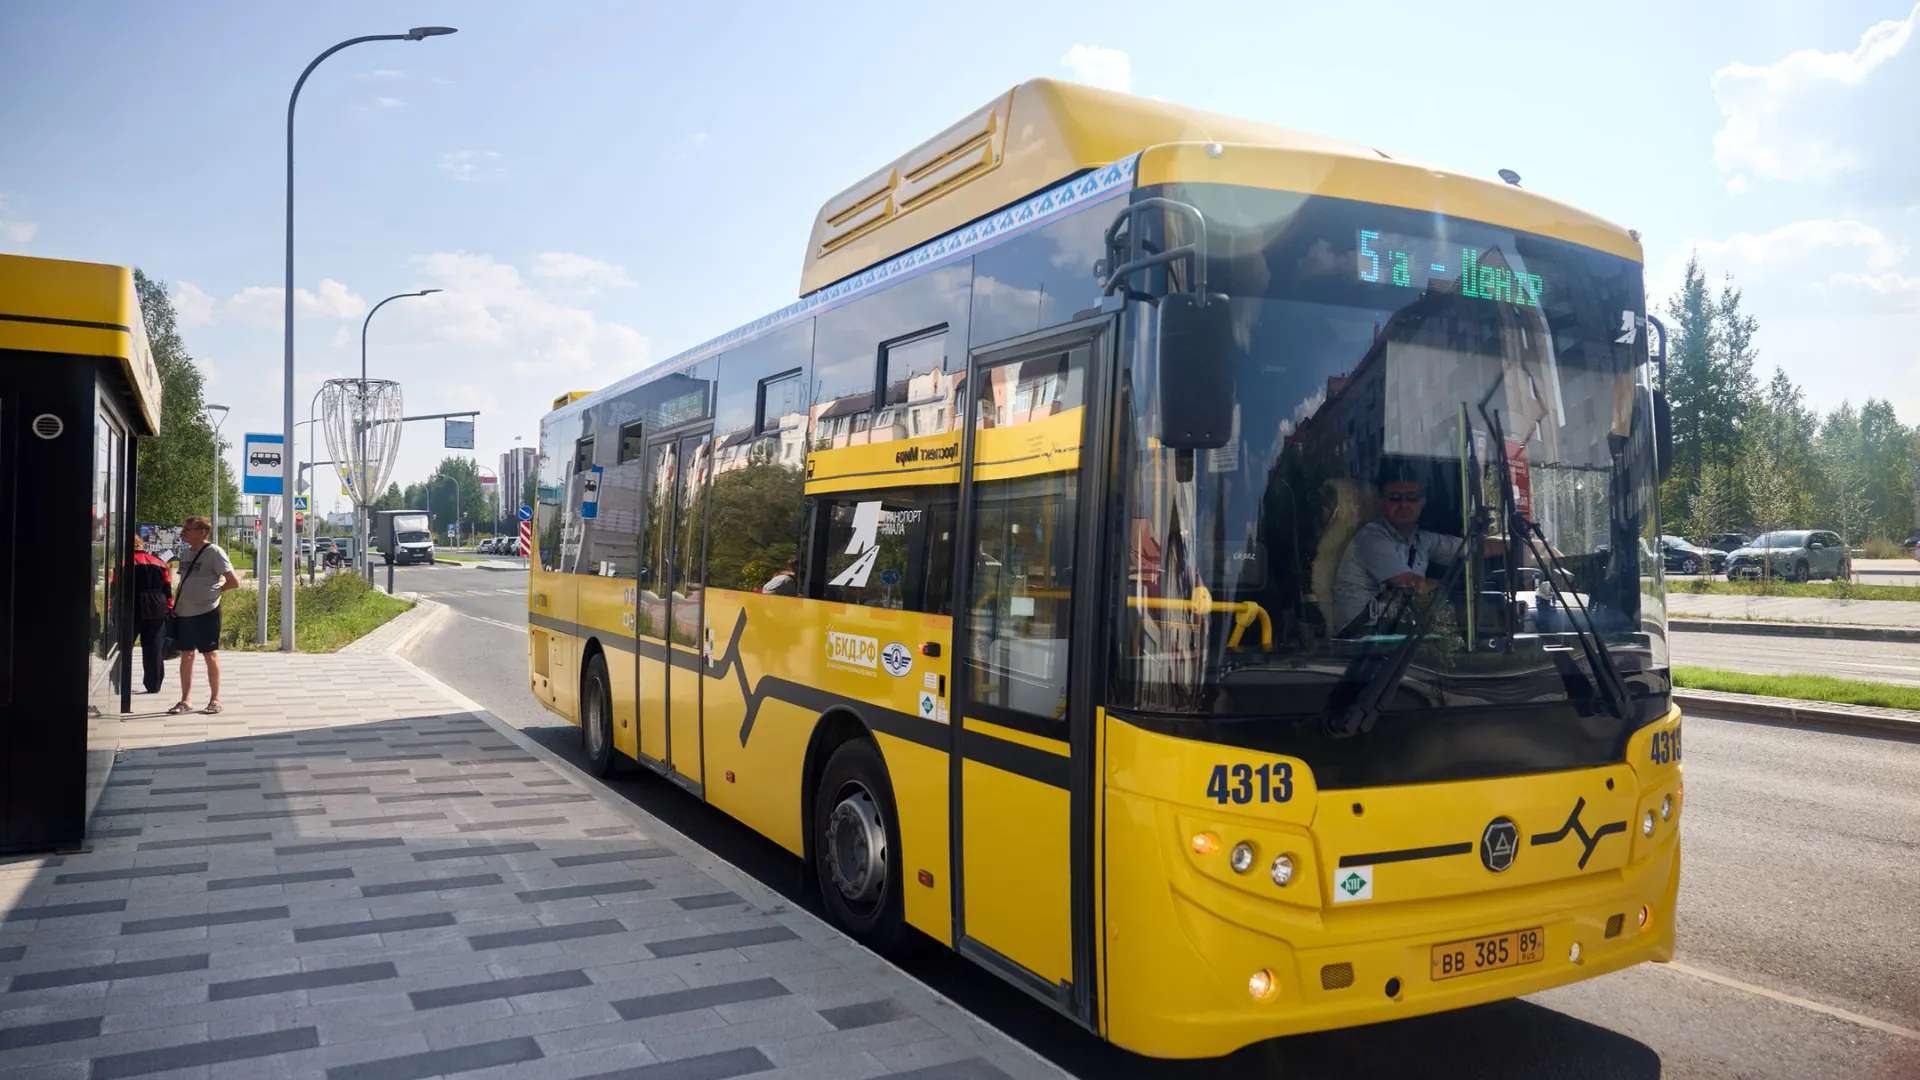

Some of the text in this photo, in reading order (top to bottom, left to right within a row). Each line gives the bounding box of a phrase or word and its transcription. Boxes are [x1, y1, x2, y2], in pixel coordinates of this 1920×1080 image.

[1463, 248, 1542, 307] Центр
[835, 636, 876, 663] БКД.РФ
[1651, 728, 1681, 764] 4313
[1207, 763, 1293, 804] 4313
[1475, 938, 1509, 967] 385
[1520, 932, 1537, 952] 89
[1521, 953, 1536, 961] RUS
